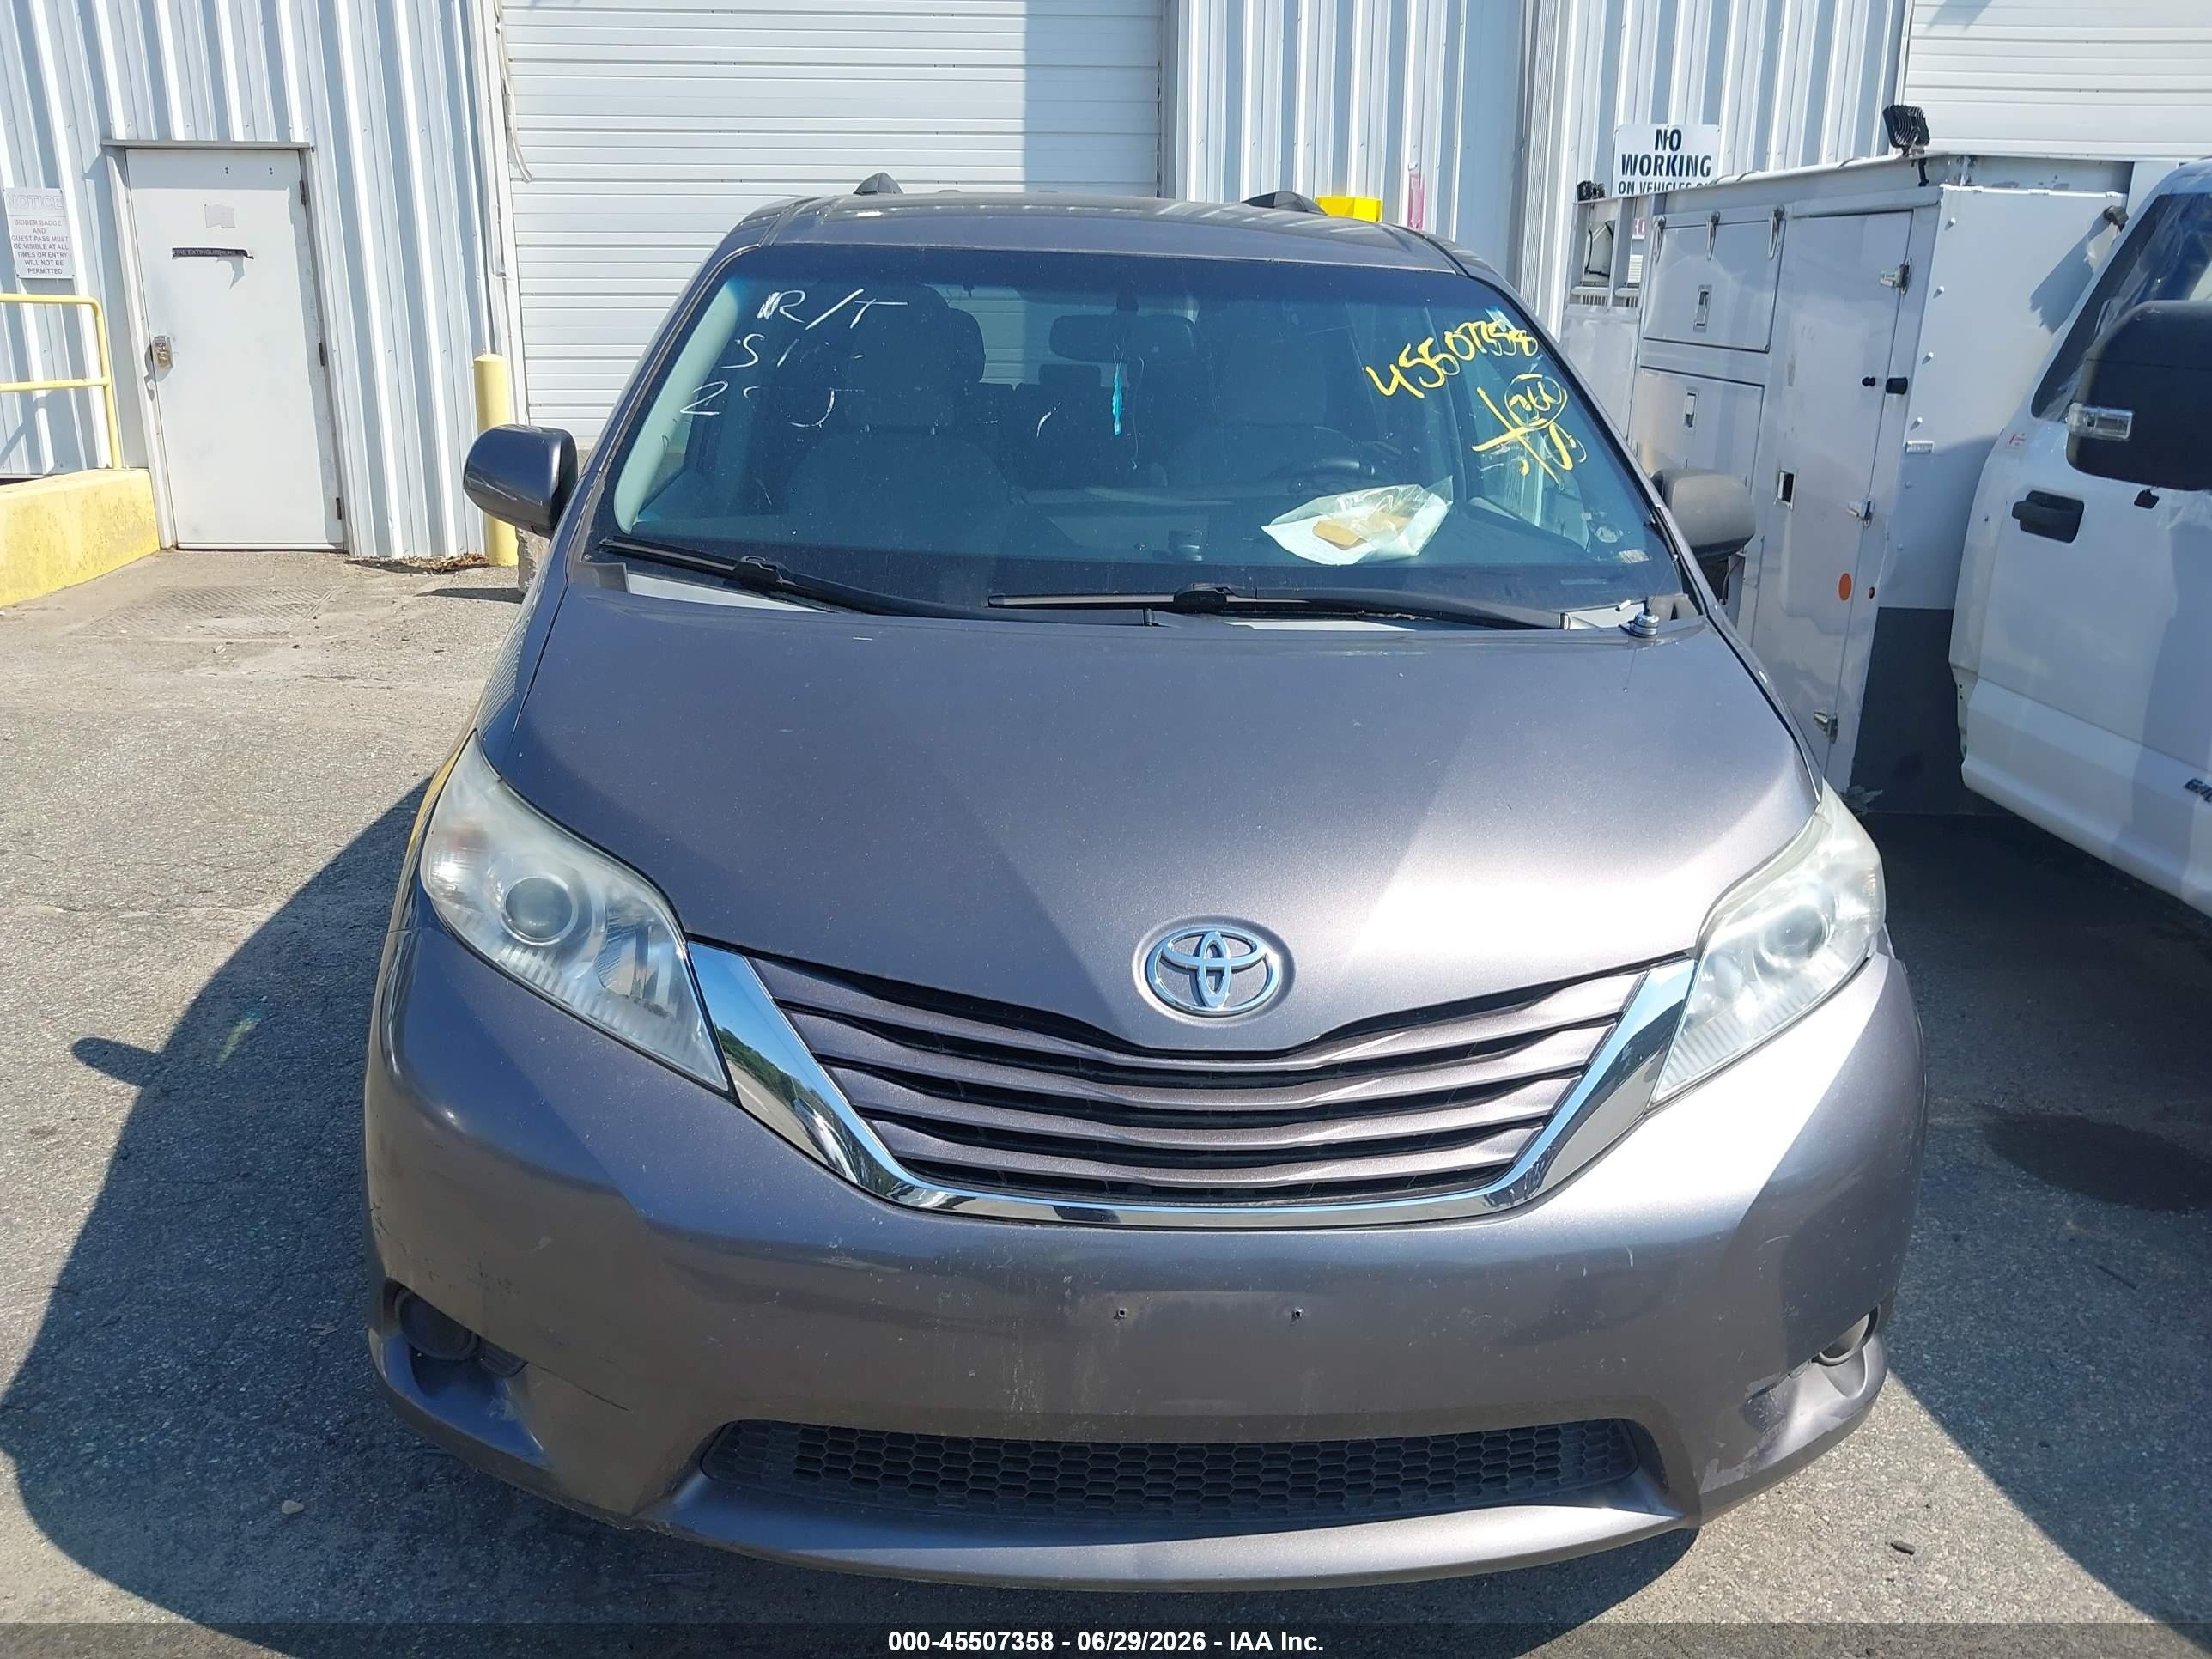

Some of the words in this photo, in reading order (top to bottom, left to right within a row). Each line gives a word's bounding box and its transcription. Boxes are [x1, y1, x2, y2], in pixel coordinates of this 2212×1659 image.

[1654, 128, 1682, 152] NO
[1621, 154, 1711, 178] WORKING
[1618, 181, 1635, 195] ON
[6, 194, 64, 210] NOTICE
